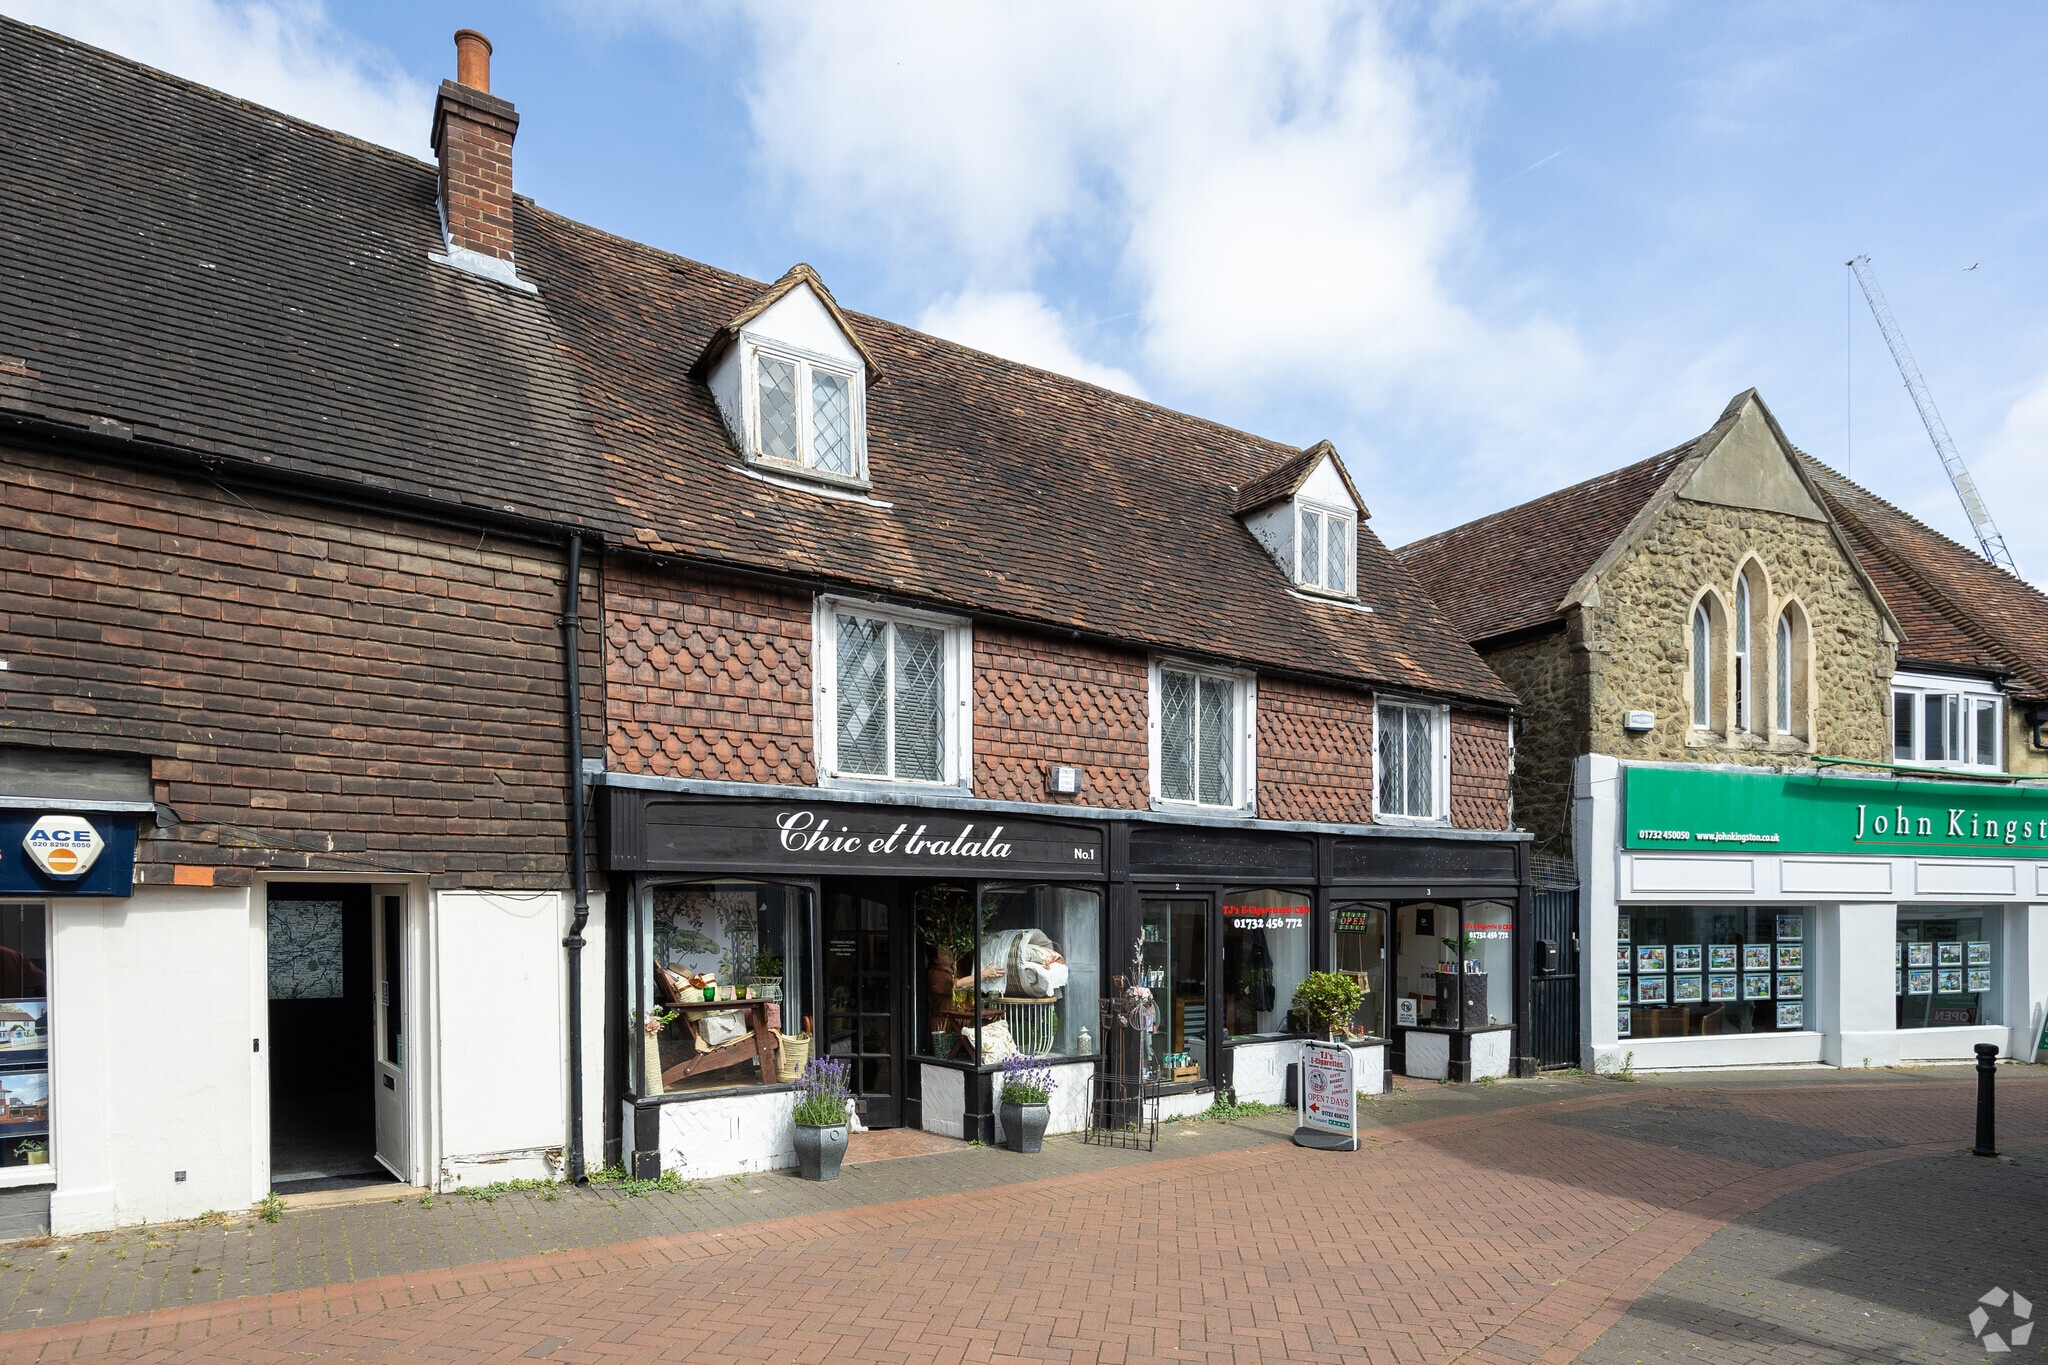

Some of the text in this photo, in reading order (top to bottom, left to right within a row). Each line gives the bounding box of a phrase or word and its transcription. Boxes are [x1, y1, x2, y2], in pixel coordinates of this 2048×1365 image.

[1856, 804, 1932, 839] John
[30, 829, 91, 842] ACE
[776, 811, 1011, 858] Chic et tralala
[1639, 830, 1780, 843] 01732 450050 www.johnkingston.co.uk
[1074, 848, 1094, 860] No.1
[1426, 888, 1431, 896] 3
[1222, 905, 1240, 915] TJ's
[1234, 918, 1303, 929] 01732 456 772
[1340, 917, 1366, 925] OPEN
[1469, 931, 1487, 939] 01732
[1487, 931, 1498, 939] 456
[1320, 1051, 1334, 1060] TJ's
[1311, 1057, 1344, 1068] E-Cigarettes
[1308, 1093, 1325, 1102] OPEN
[1331, 1097, 1349, 1107] DAYS
